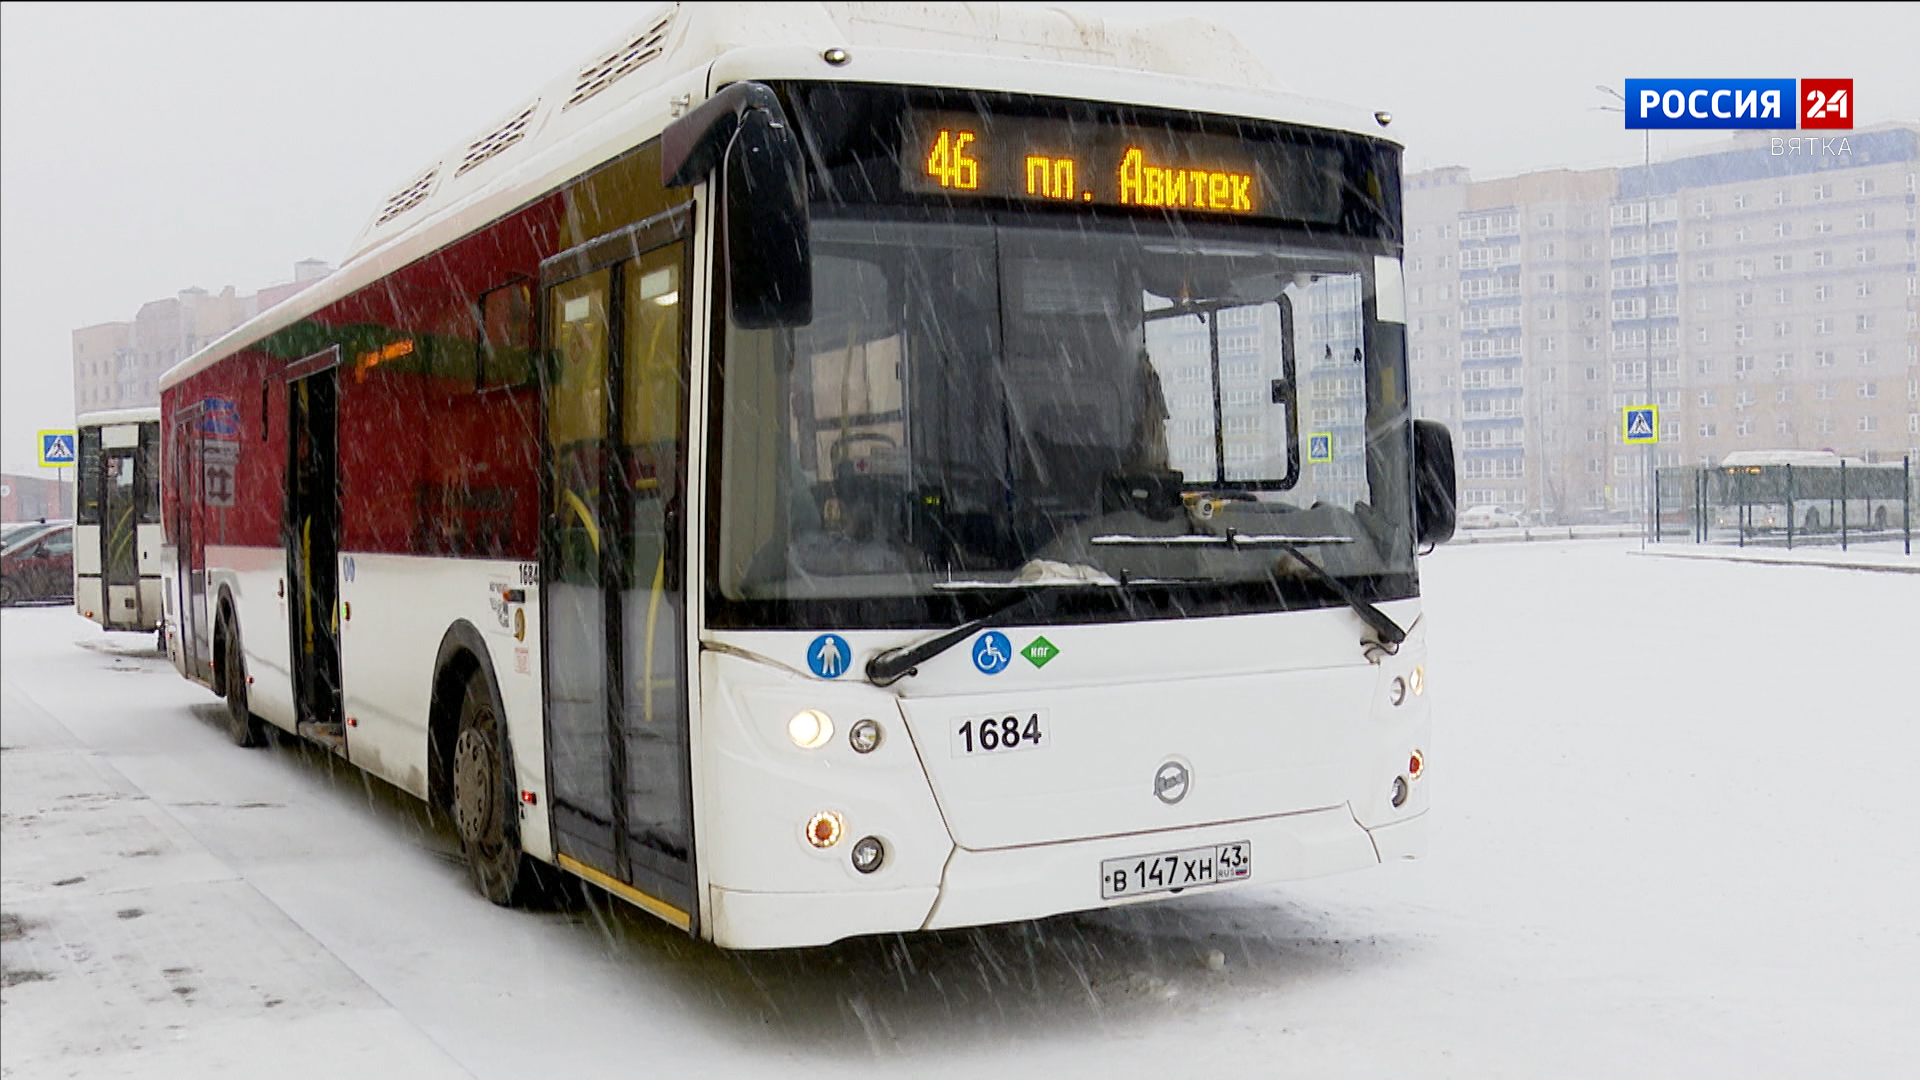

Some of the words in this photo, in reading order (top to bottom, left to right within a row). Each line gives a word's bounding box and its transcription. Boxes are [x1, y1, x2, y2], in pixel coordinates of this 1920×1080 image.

[927, 130, 978, 190] 46
[1025, 155, 1093, 202] пл.
[1119, 148, 1252, 211] Авитек
[519, 563, 539, 586] 1684
[1030, 646, 1050, 658] КПГ
[958, 713, 1042, 752] 1684
